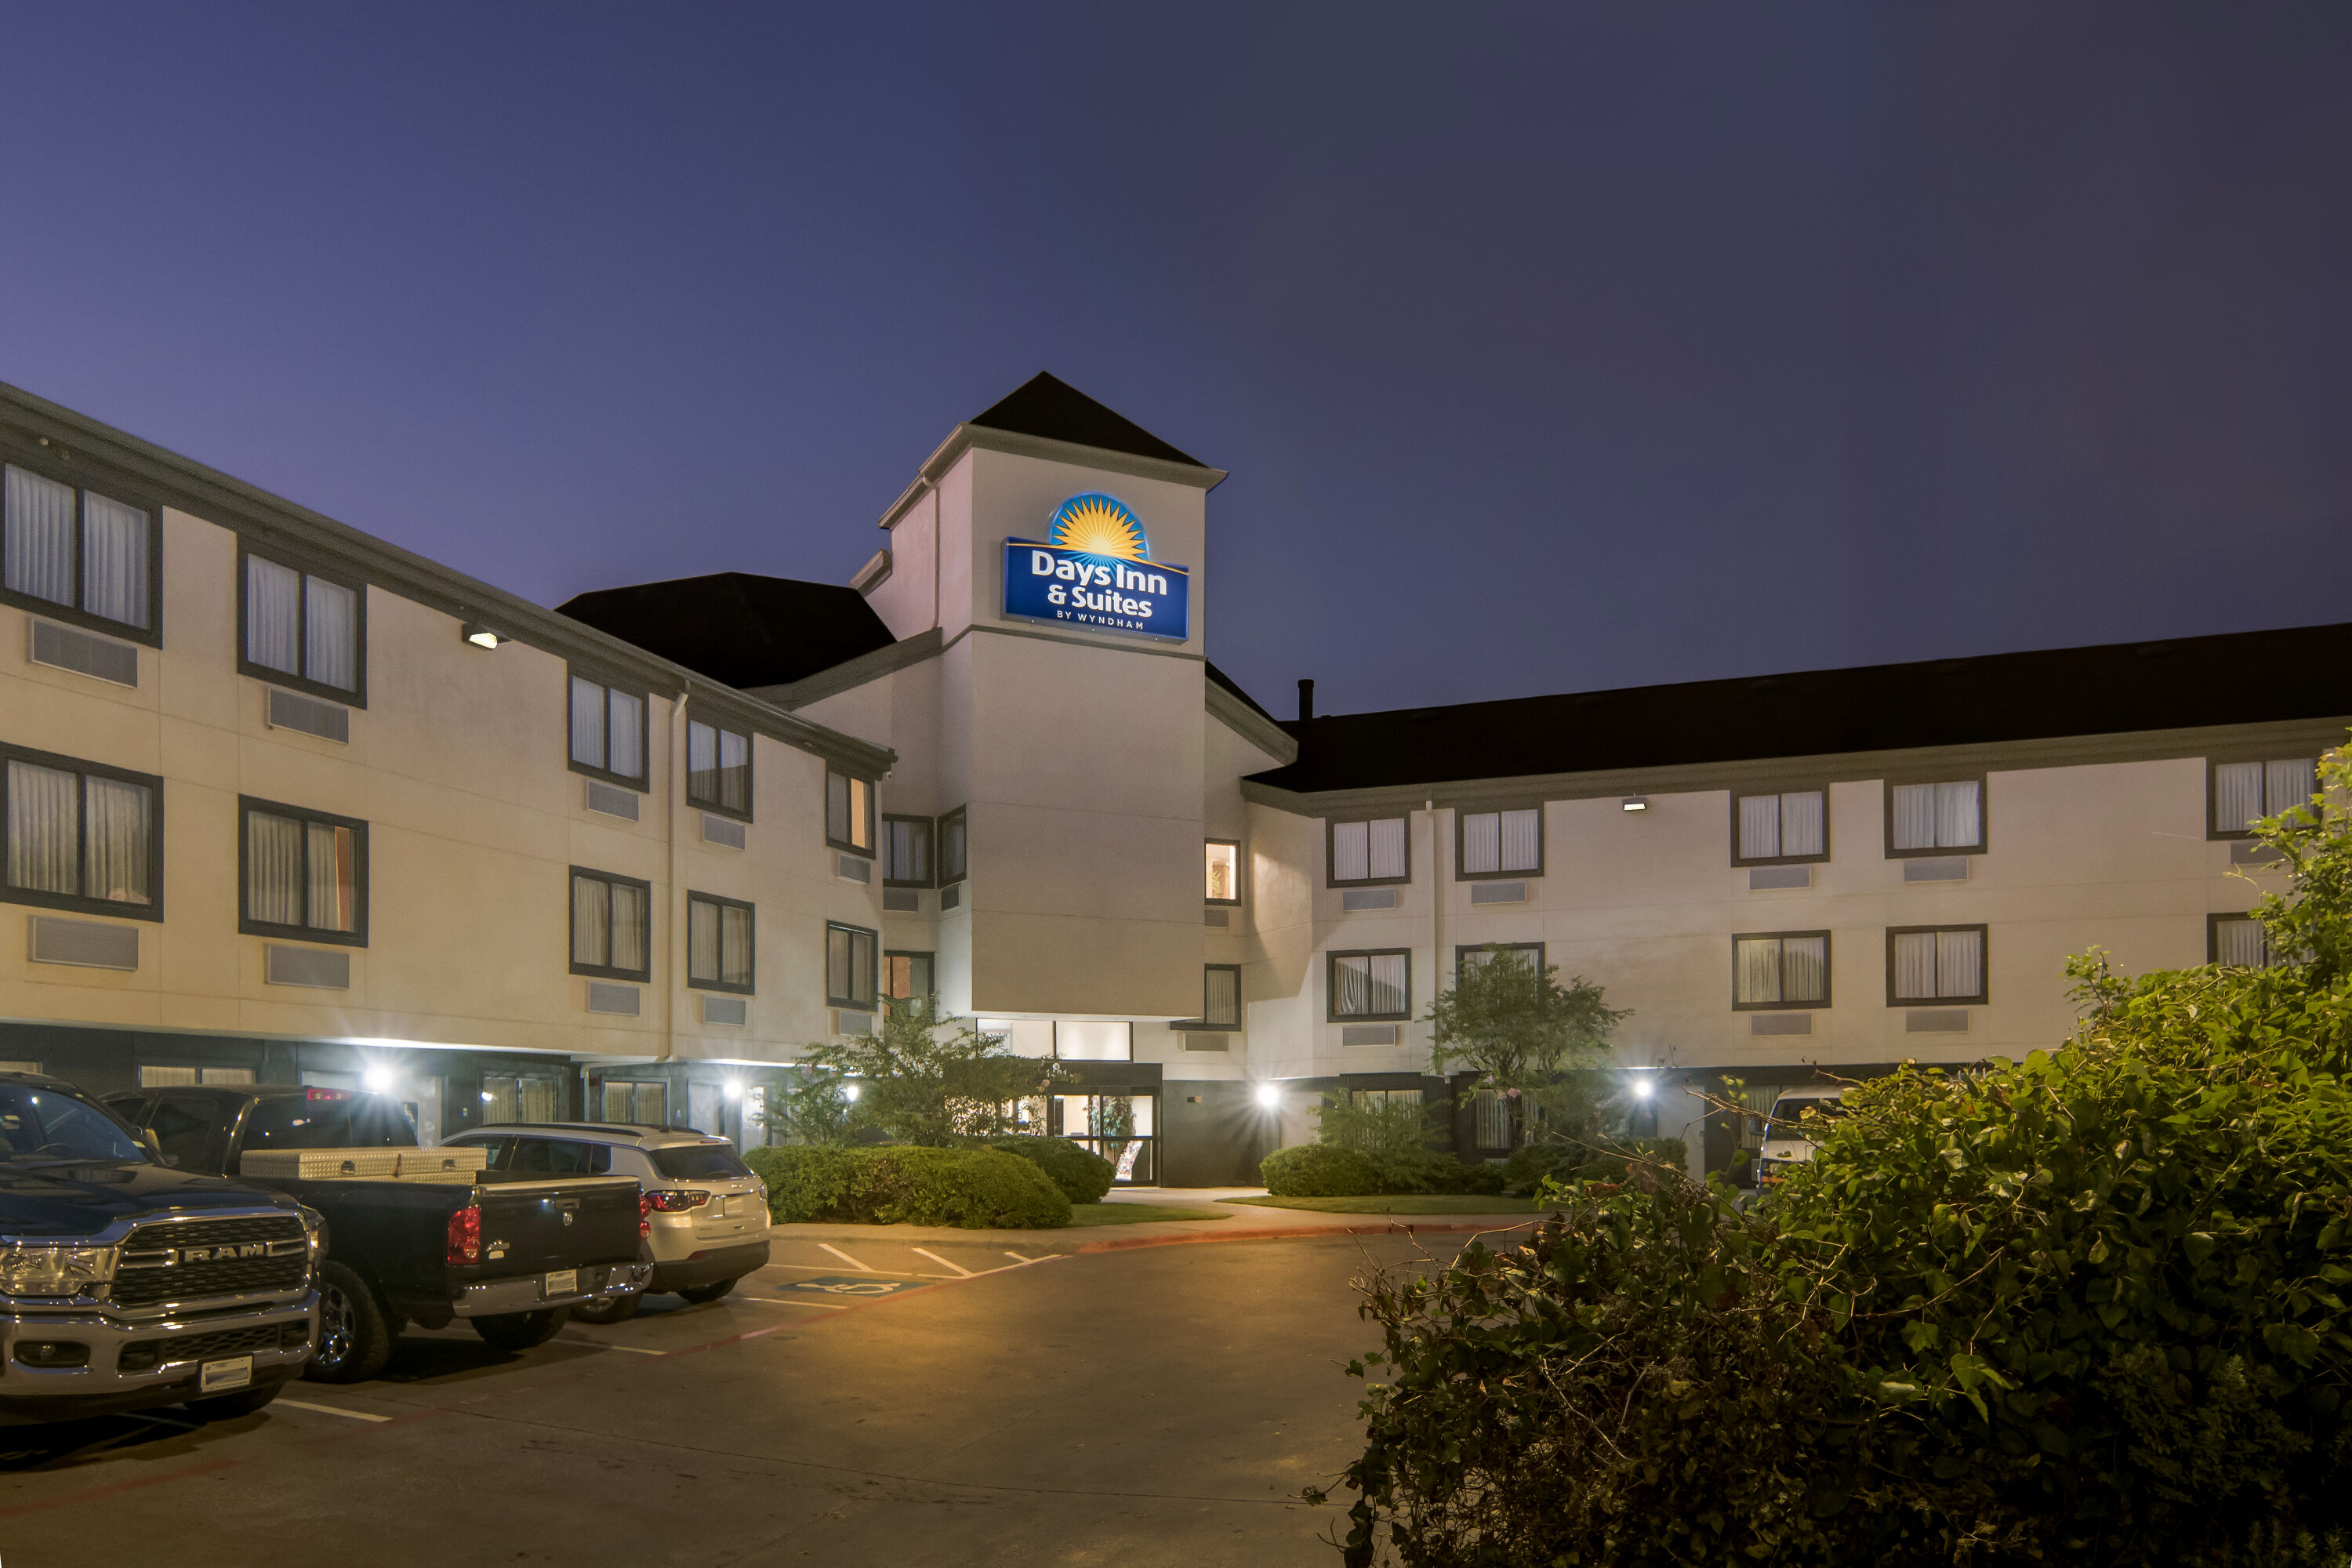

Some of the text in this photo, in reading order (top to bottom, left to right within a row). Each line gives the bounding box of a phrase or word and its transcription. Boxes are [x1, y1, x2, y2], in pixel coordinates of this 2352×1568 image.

[1032, 550, 1167, 595] Days Inn
[1047, 584, 1152, 618] & Suites
[1057, 610, 1143, 630] BY WYNDHAM
[184, 1244, 265, 1262] RAM
